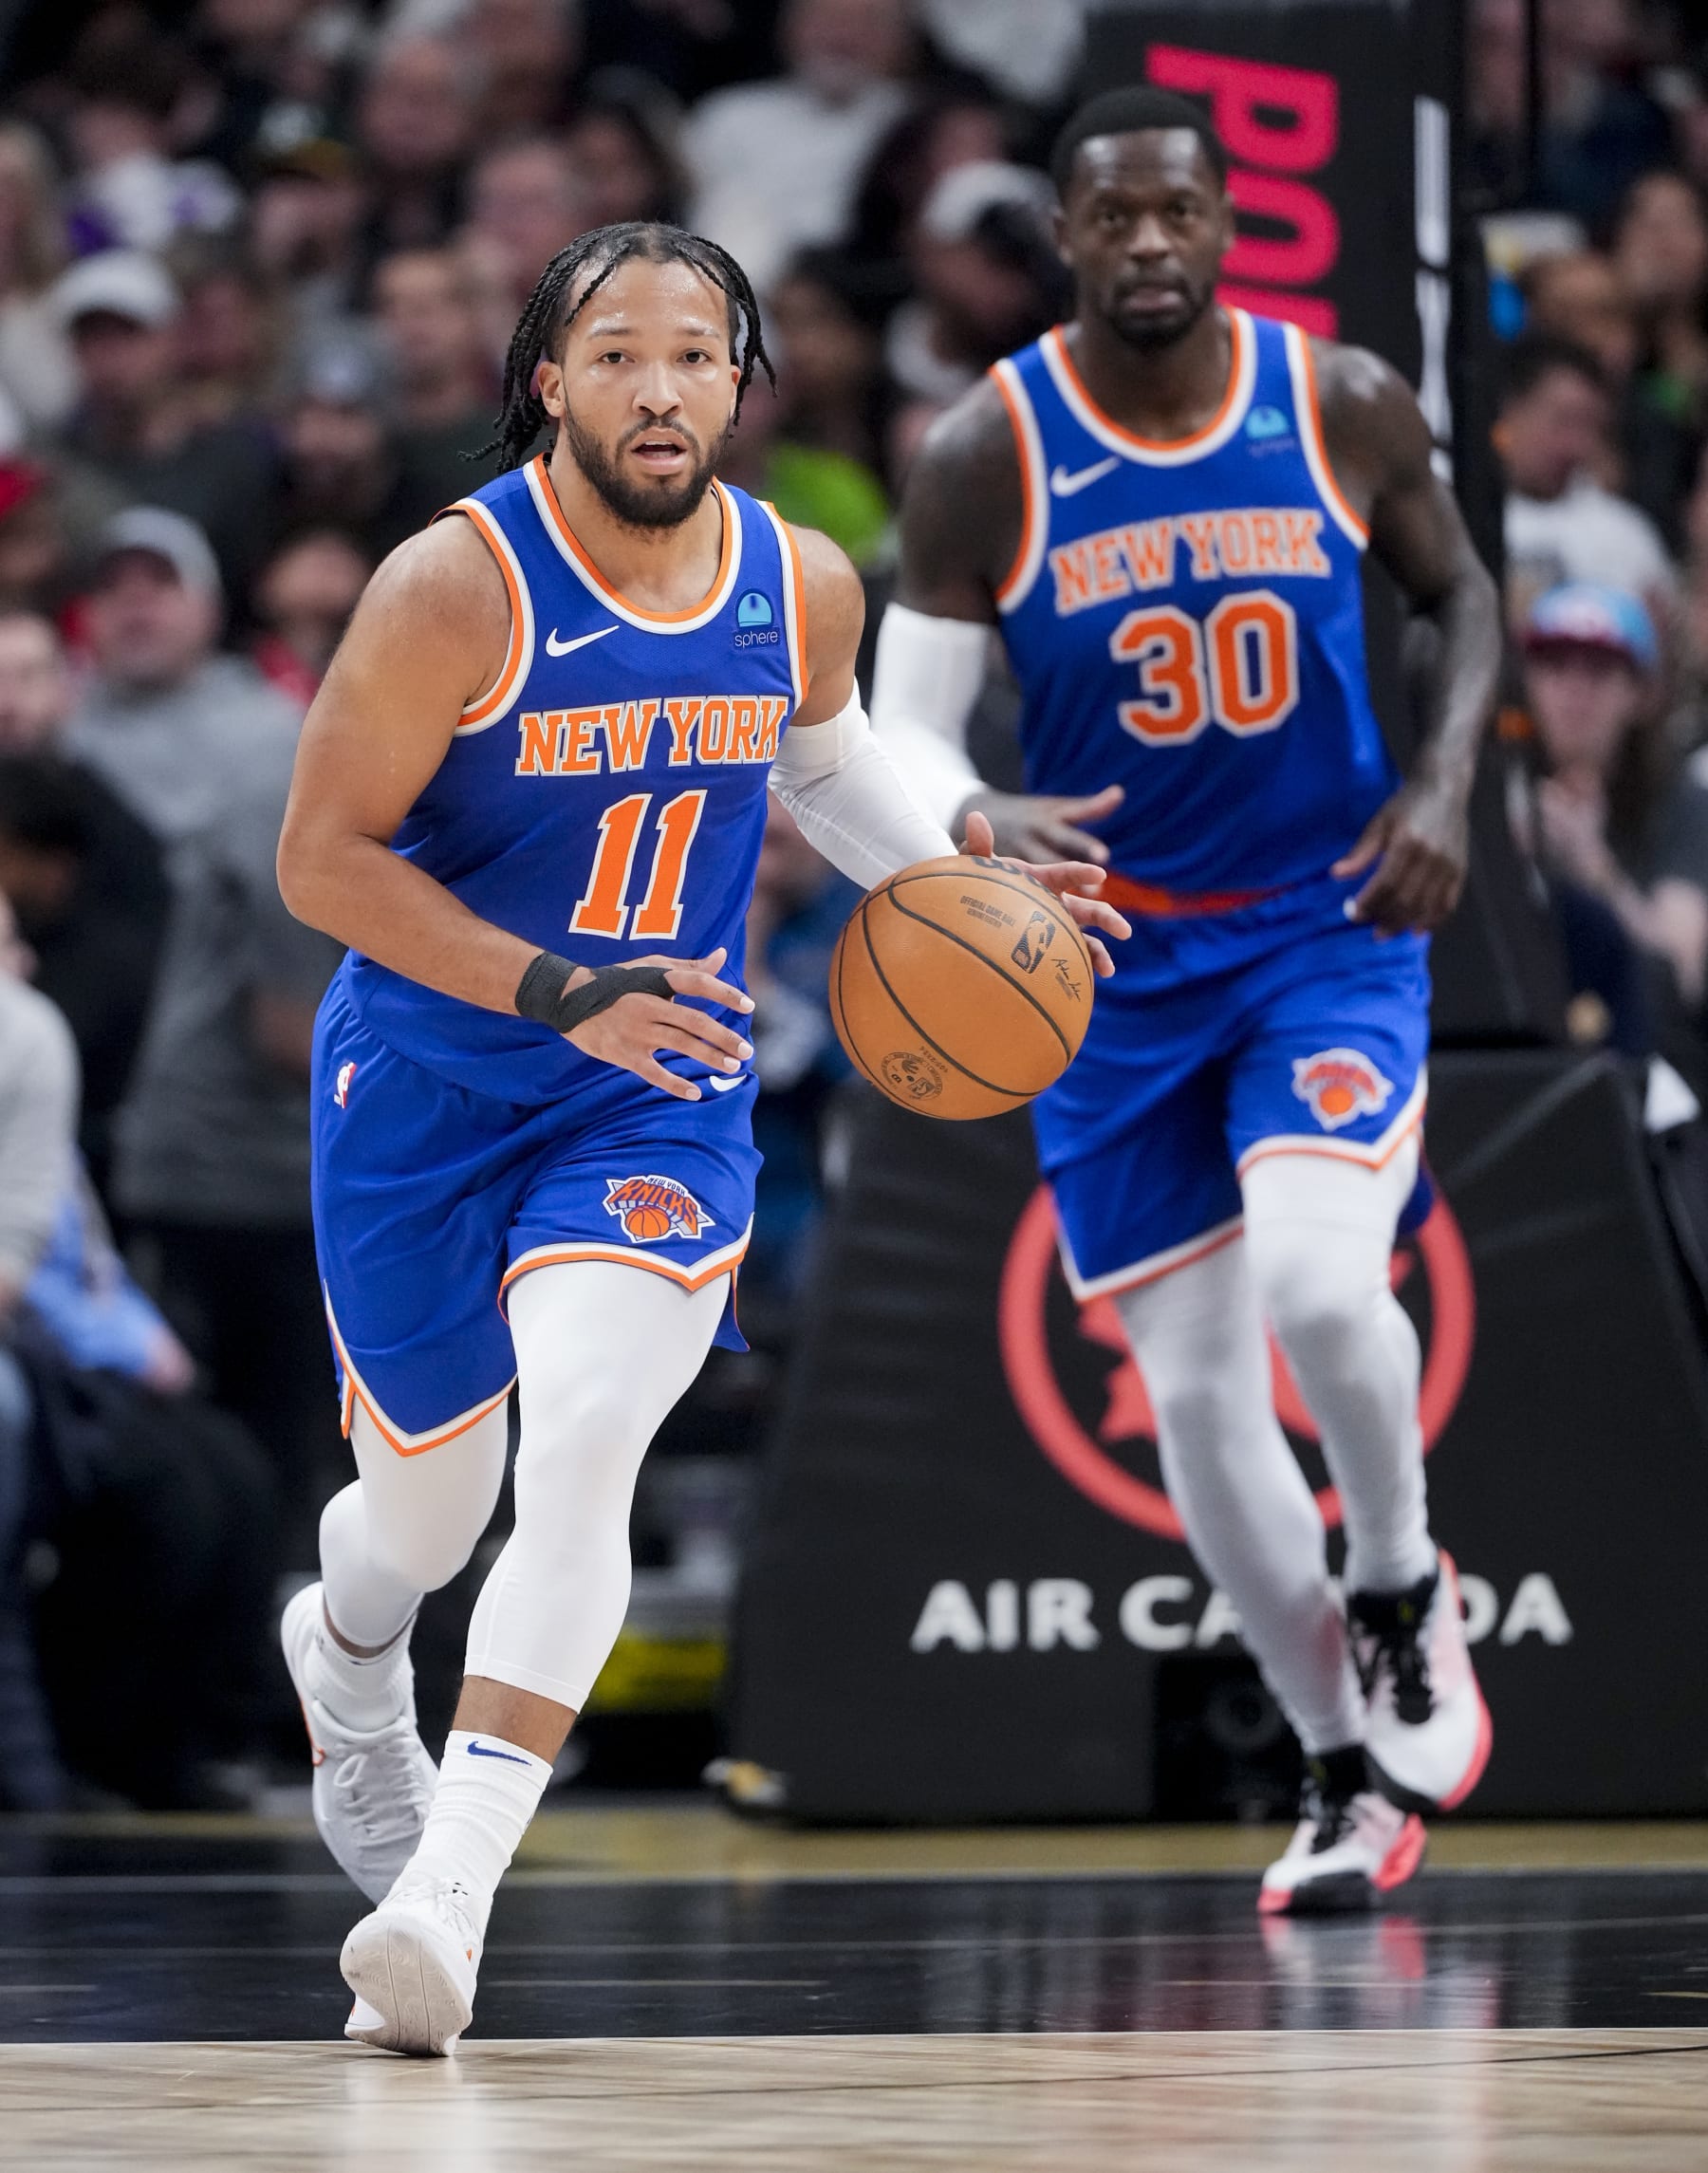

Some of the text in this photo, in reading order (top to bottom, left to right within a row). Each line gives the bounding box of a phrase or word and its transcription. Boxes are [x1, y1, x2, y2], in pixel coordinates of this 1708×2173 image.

[1049, 507, 1332, 618] NEW YORK
[734, 630, 778, 650] sphere
[1108, 587, 1300, 748] 30
[514, 695, 789, 776] NEW YORK
[568, 789, 708, 939] 11
[607, 1179, 698, 1235] KNICKS
[646, 1177, 686, 1197] NEW YORK
[911, 1576, 1103, 1653] AIR
